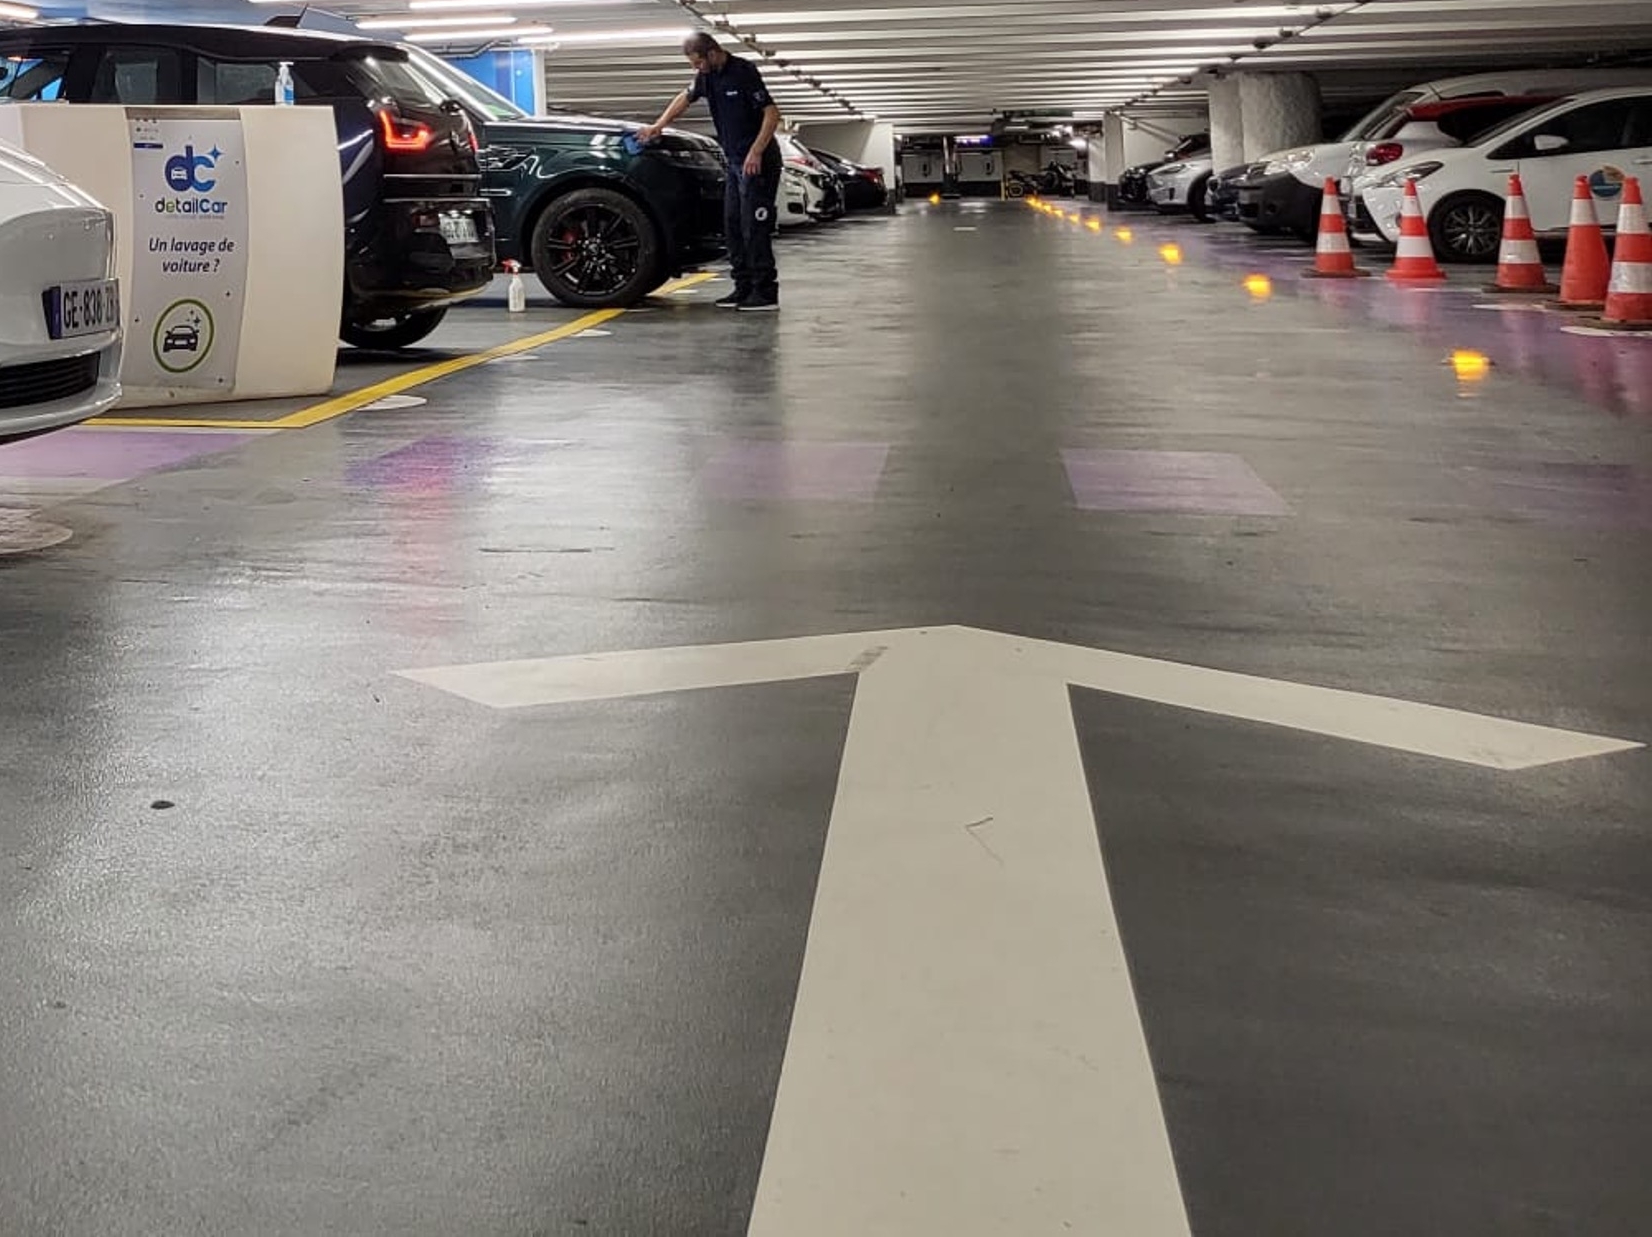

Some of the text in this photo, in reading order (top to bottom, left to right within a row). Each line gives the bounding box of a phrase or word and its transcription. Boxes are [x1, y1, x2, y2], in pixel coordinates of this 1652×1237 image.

[154, 197, 228, 214] detailCar
[149, 237, 235, 256] Un lavage de
[162, 258, 220, 273] voiture ?
